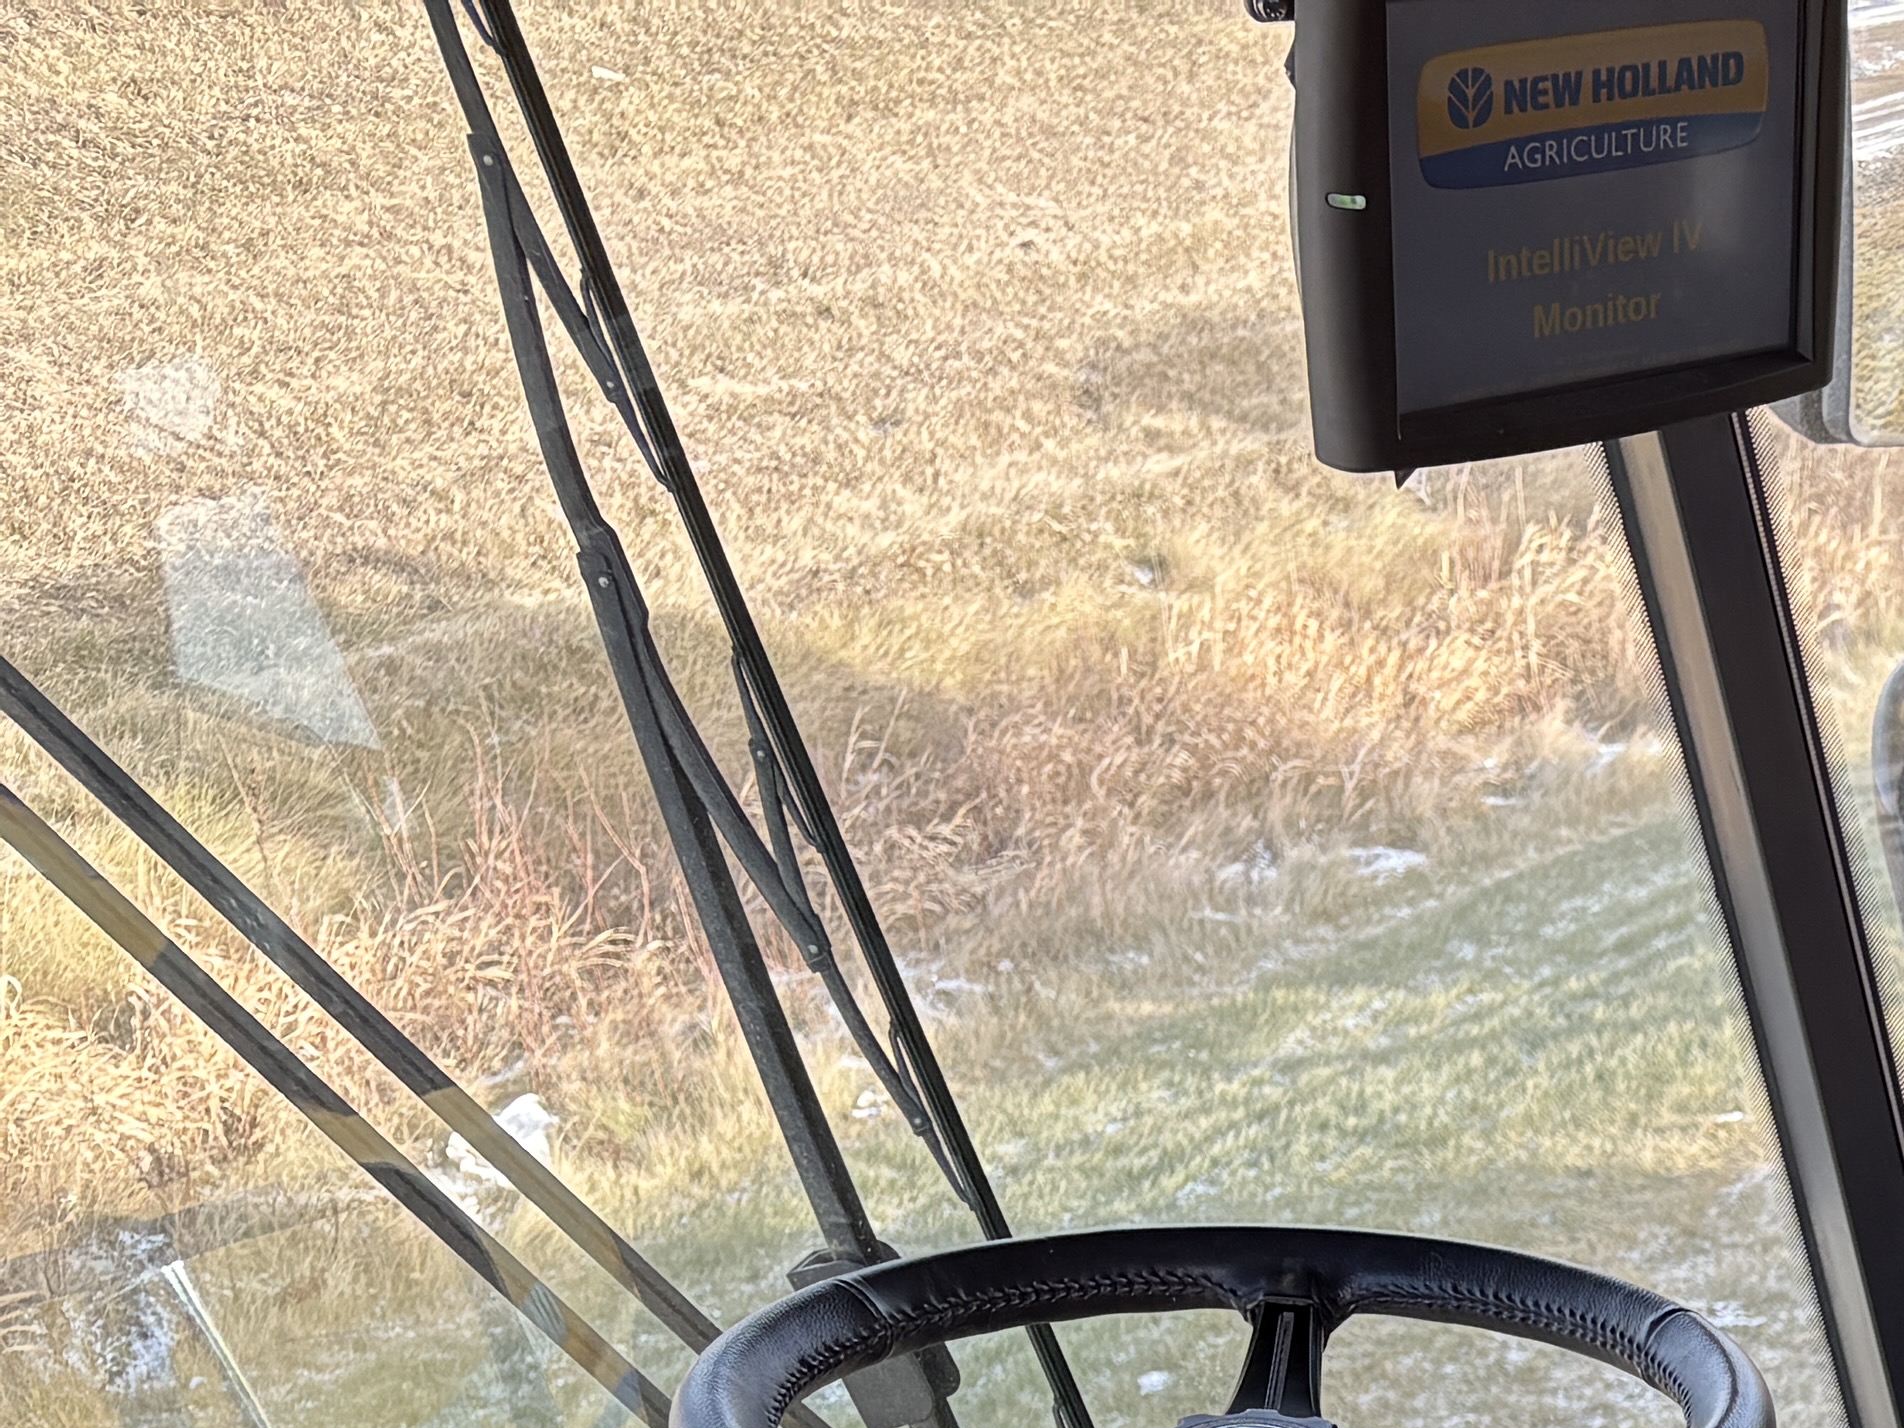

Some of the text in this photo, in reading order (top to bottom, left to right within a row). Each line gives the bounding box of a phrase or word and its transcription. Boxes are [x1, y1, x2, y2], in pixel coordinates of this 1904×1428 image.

[1503, 50, 1745, 116] NEW HOLLAND
[1503, 121, 1689, 172] AGRICULTURE
[1486, 216, 1705, 285] IntelliView IV
[1532, 291, 1662, 340] Monitor
